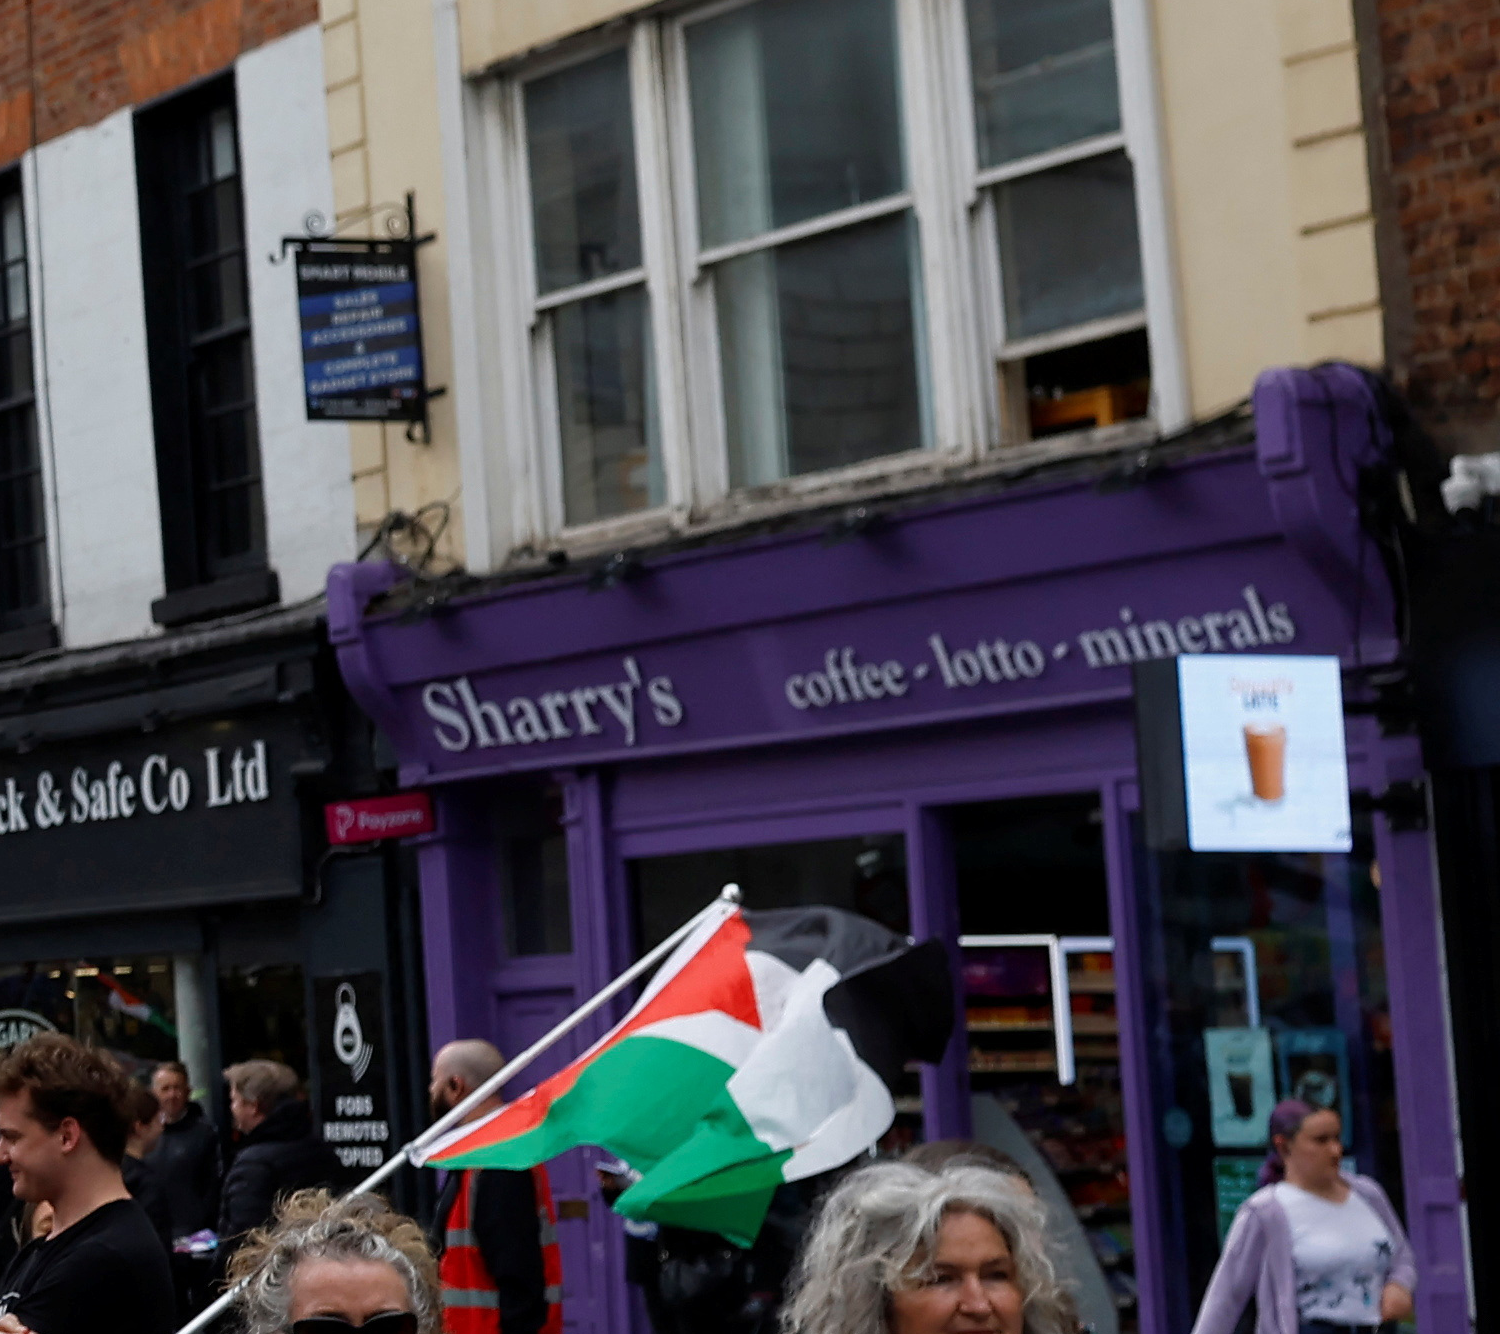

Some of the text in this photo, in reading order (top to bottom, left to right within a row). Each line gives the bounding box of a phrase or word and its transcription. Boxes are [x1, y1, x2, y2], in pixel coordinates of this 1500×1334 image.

[785, 646, 910, 710] coffee
[927, 633, 1046, 688] lotto
[1077, 584, 1296, 668] minerals
[422, 655, 683, 753] Sharry's
[34, 770, 66, 829] &
[70, 759, 137, 824] Safe
[140, 754, 191, 815] Co
[204, 739, 270, 809] Ltd
[323, 1120, 390, 1142] REMOTES
[334, 1095, 374, 1117] FOBS
